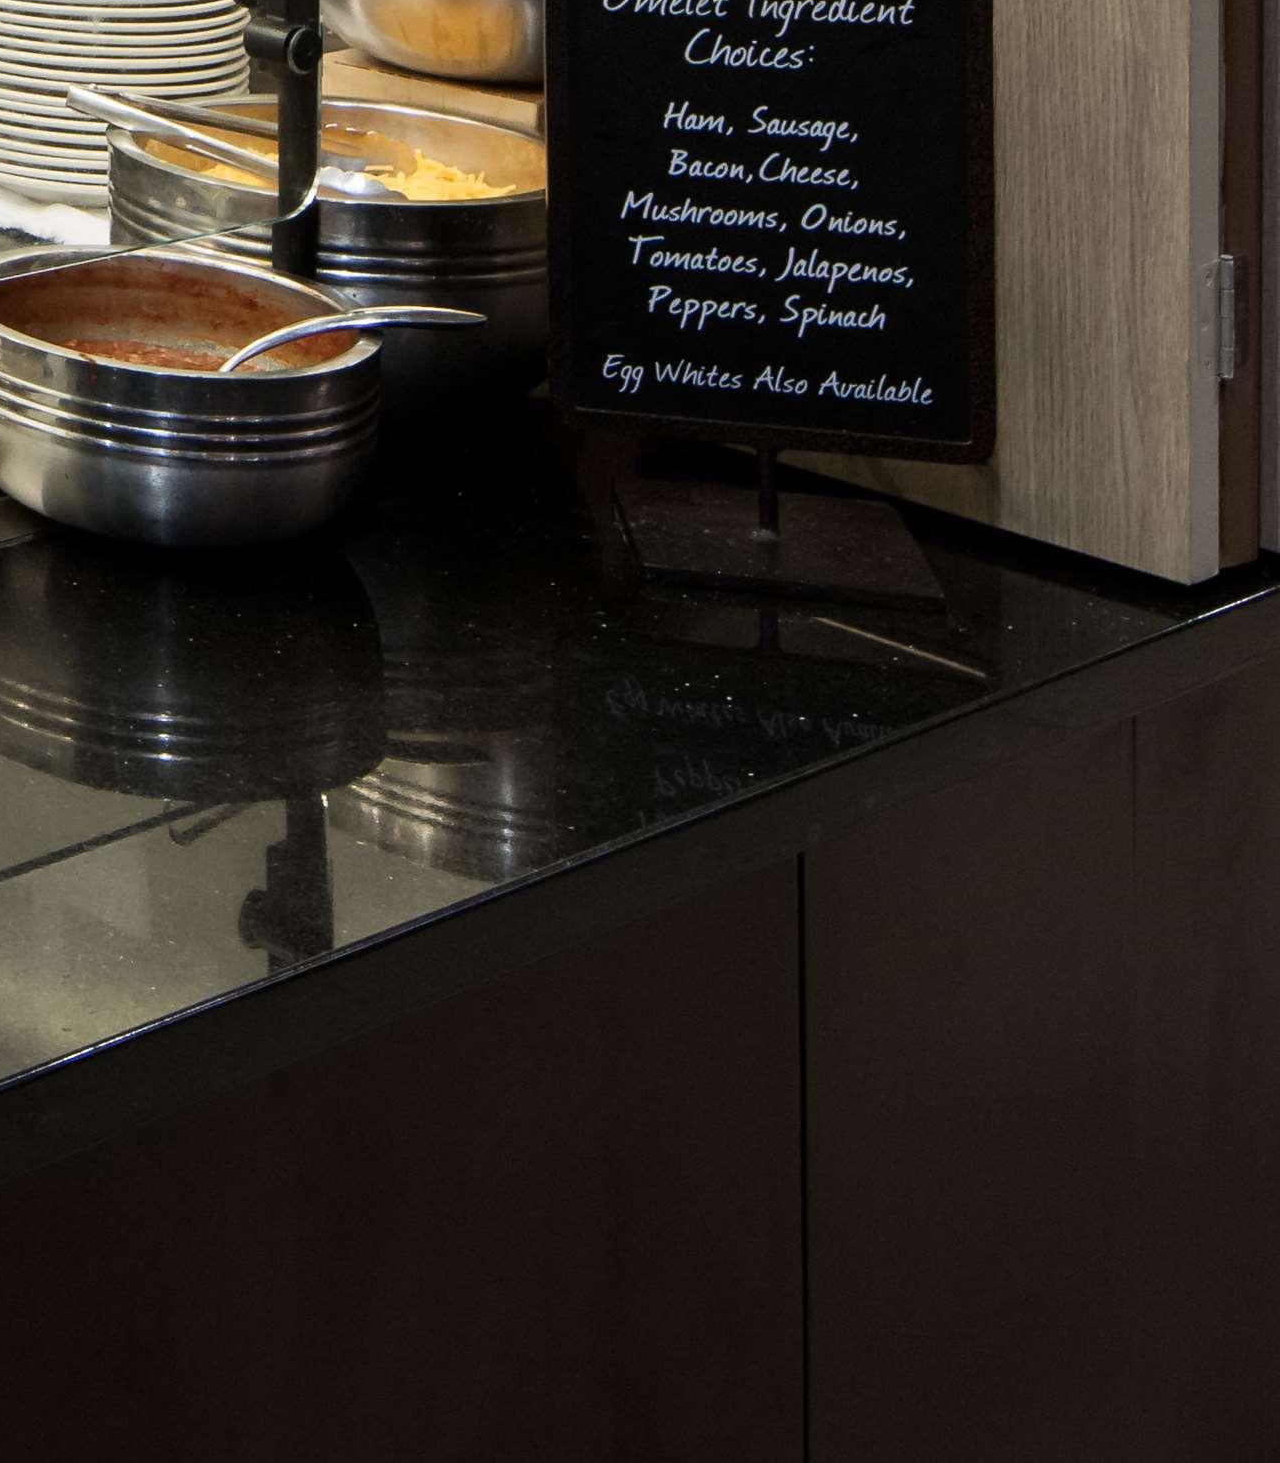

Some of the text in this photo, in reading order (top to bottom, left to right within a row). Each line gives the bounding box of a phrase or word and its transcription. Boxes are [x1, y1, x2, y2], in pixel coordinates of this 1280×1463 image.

[684, 28, 816, 70] Choices:
[662, 101, 859, 152] Ham, Sausage,
[667, 148, 860, 190] Bacon, Cheese,
[620, 190, 907, 241] Mushrooms, Onions,
[628, 235, 916, 294] Tomatoes, Jalapenos,
[648, 285, 887, 338] Peppers, Spinach
[602, 353, 934, 406] Egg Whites Also Available
